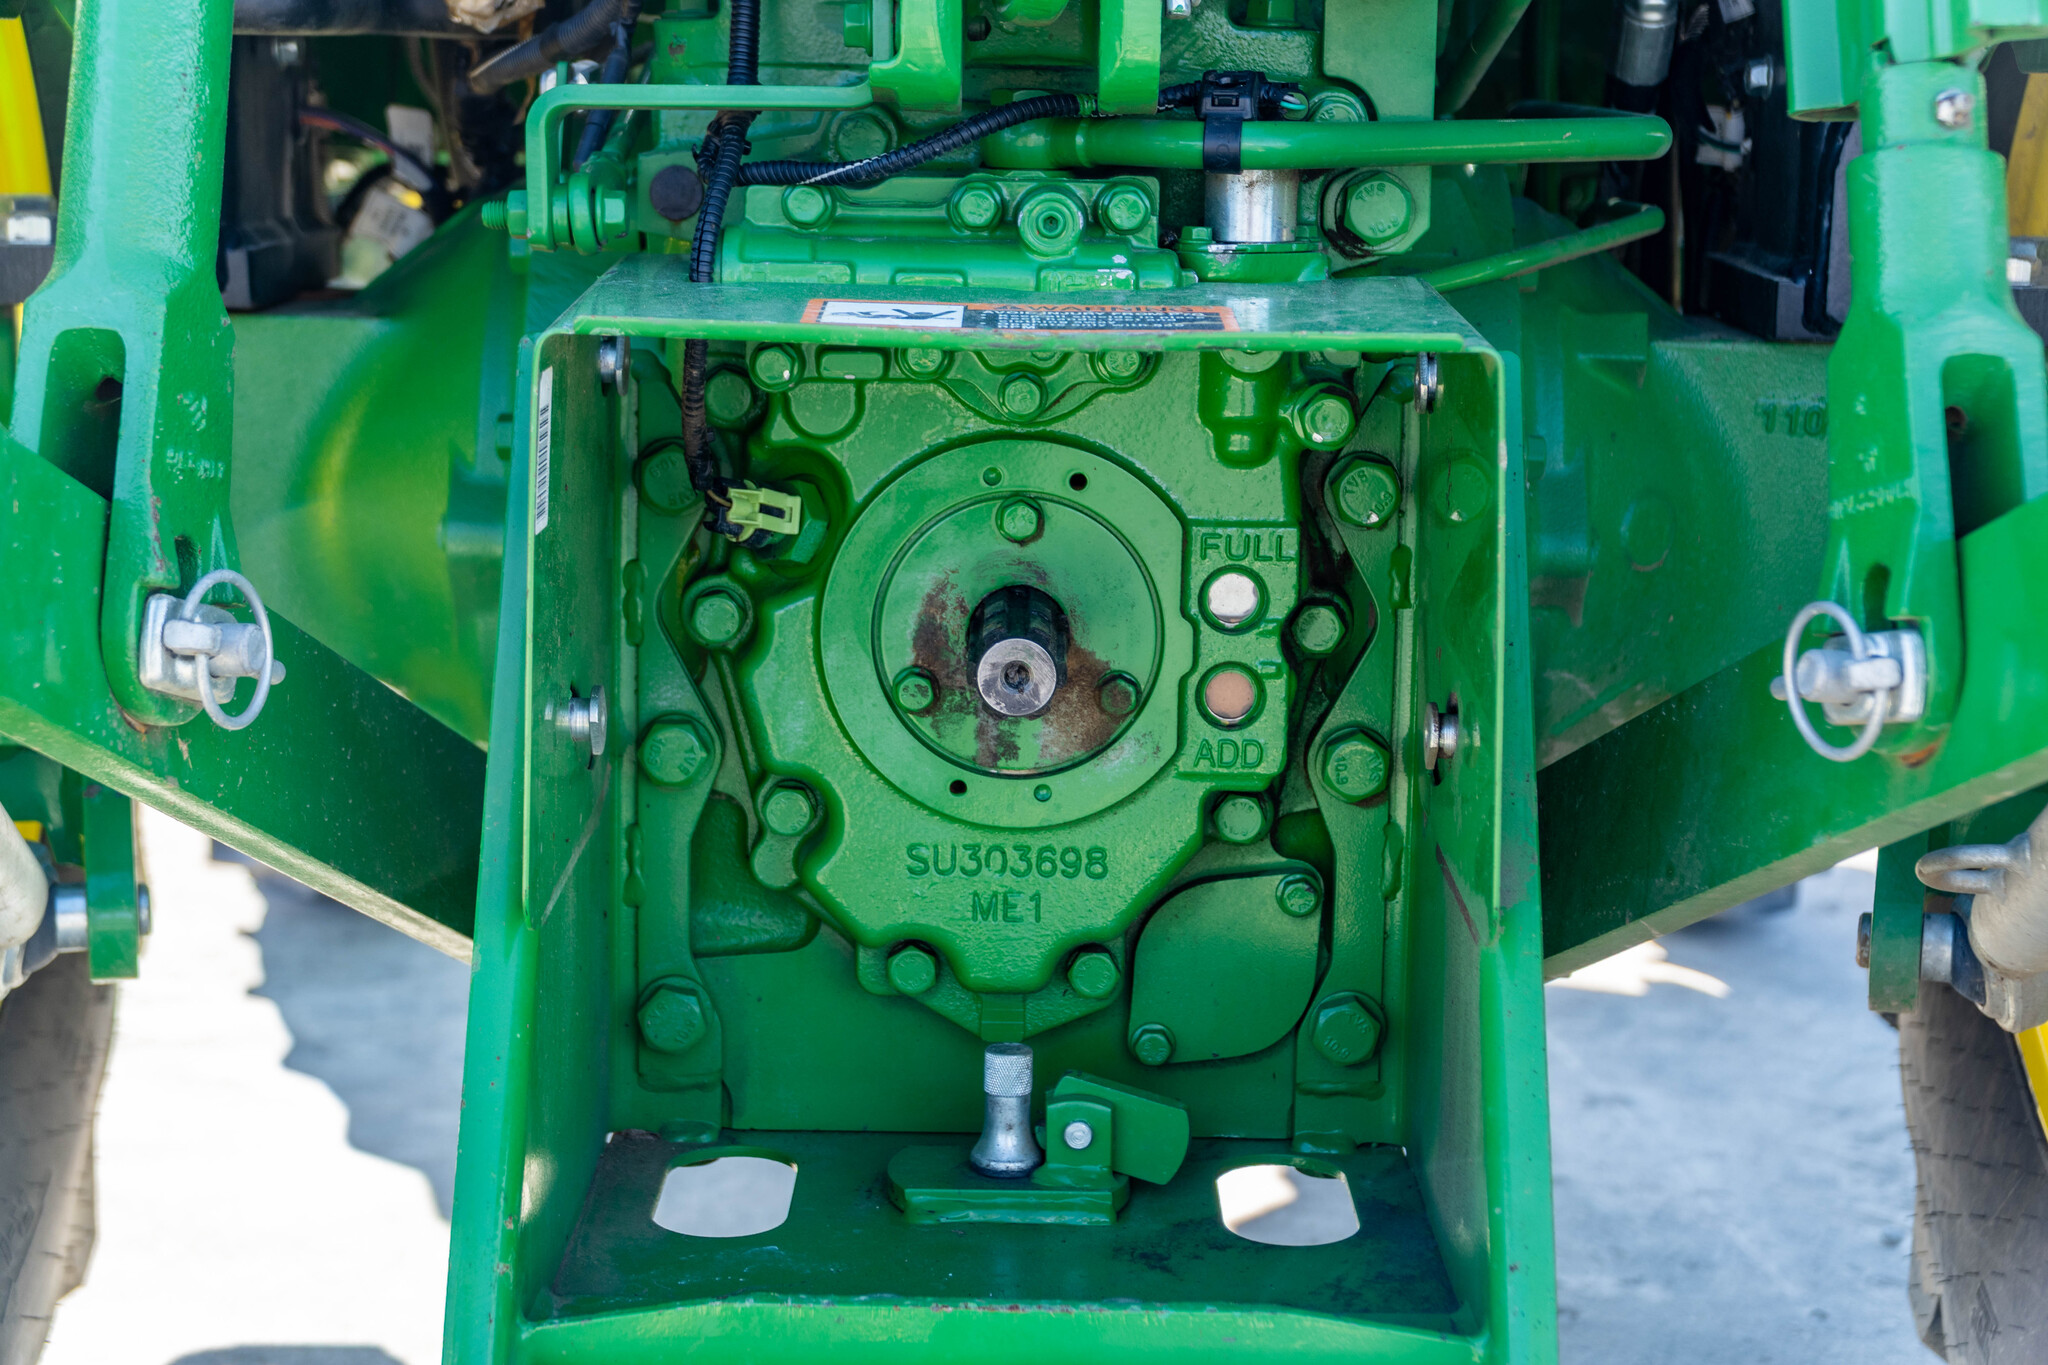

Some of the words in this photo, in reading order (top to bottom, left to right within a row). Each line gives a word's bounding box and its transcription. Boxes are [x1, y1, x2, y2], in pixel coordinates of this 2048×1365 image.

[1355, 182, 1386, 203] TVS
[1344, 469, 1369, 496] TVS
[1200, 532, 1295, 562] FULL
[1193, 738, 1264, 769] ADD
[1335, 756, 1349, 786] 10.9
[906, 842, 1109, 880] SU303698
[971, 889, 1042, 923] ME1
